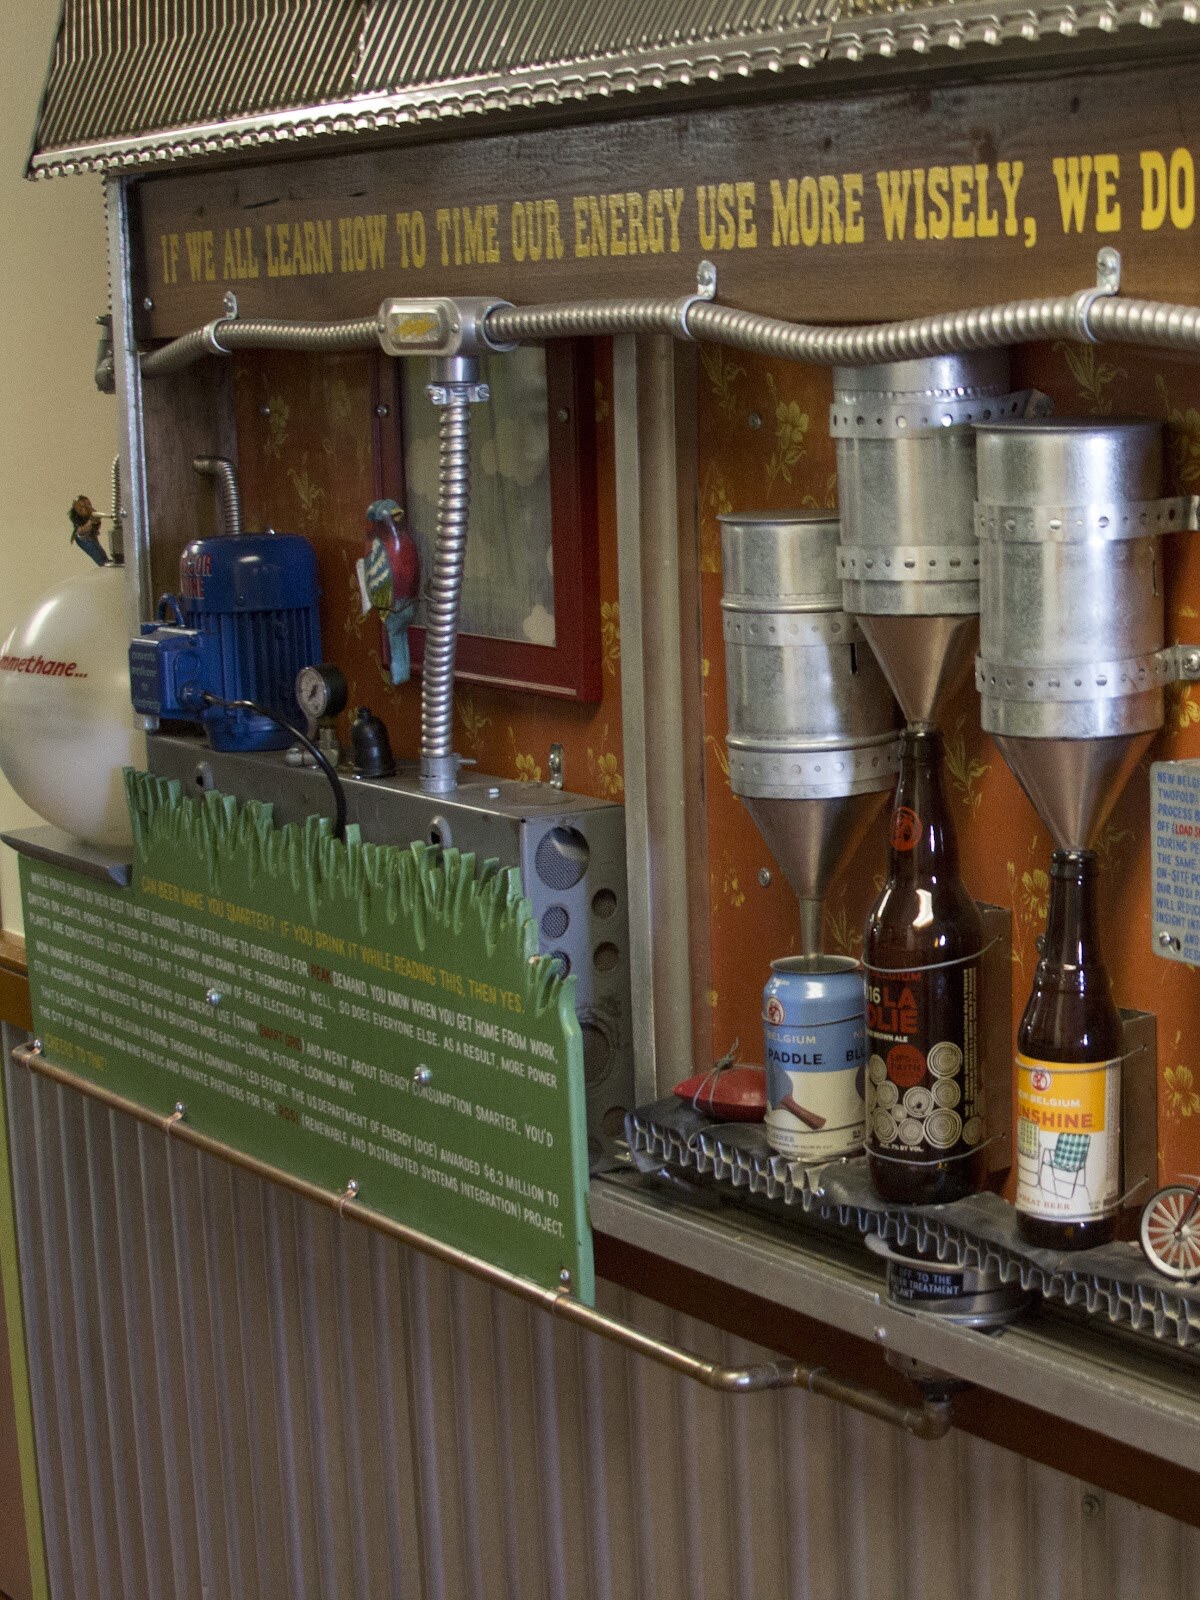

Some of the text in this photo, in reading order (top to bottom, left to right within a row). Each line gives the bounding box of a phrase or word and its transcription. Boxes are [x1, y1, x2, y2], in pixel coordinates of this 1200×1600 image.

[161, 233, 179, 283] IF
[185, 231, 216, 282] WE
[223, 227, 259, 280] ALL
[265, 219, 333, 277] LEARN
[339, 214, 388, 272] HOW
[396, 211, 427, 268] TO
[436, 204, 499, 266] TIME
[511, 198, 564, 262] OUR
[573, 188, 684, 257] ENERGY
[697, 182, 757, 250] USE
[770, 174, 864, 247] MORE
[876, 160, 1036, 248] WISELY,
[1052, 154, 1121, 234] WE
[1140, 147, 1195, 230] DO
[1157, 772, 1175, 784] NEW
[1158, 803, 1192, 819] PROCESS
[1157, 836, 1188, 852] DURING
[394, 955, 436, 986] READING
[468, 979, 497, 1004] THEN
[883, 986, 918, 1010] LA
[370, 984, 387, 1004] YOU
[387, 989, 410, 1012] KNOW
[411, 998, 437, 1021] WHEN
[438, 1006, 456, 1027] YOU
[456, 1012, 473, 1033] GET
[475, 1019, 500, 1042] HOME
[501, 1028, 527, 1051] FROM
[372, 1012, 415, 1039] EVERYONE
[443, 1036, 454, 1053] AS
[501, 1056, 526, 1077] MORE
[528, 1066, 558, 1089] POWER
[350, 1059, 377, 1080] ABOUT
[379, 1069, 410, 1092] ENERGY
[524, 1123, 554, 1148] YOU'D
[1030, 1094, 1081, 1107] BELGIUM
[368, 1142, 419, 1175] DISTRIBUTED
[421, 1164, 459, 1192] SYSTEMS
[381, 1124, 412, 1148] ENERGY
[440, 1148, 480, 1176] AWARDED
[506, 1174, 544, 1203] MILLION
[547, 1190, 559, 1209] TO
[933, 1275, 952, 1285] THE
